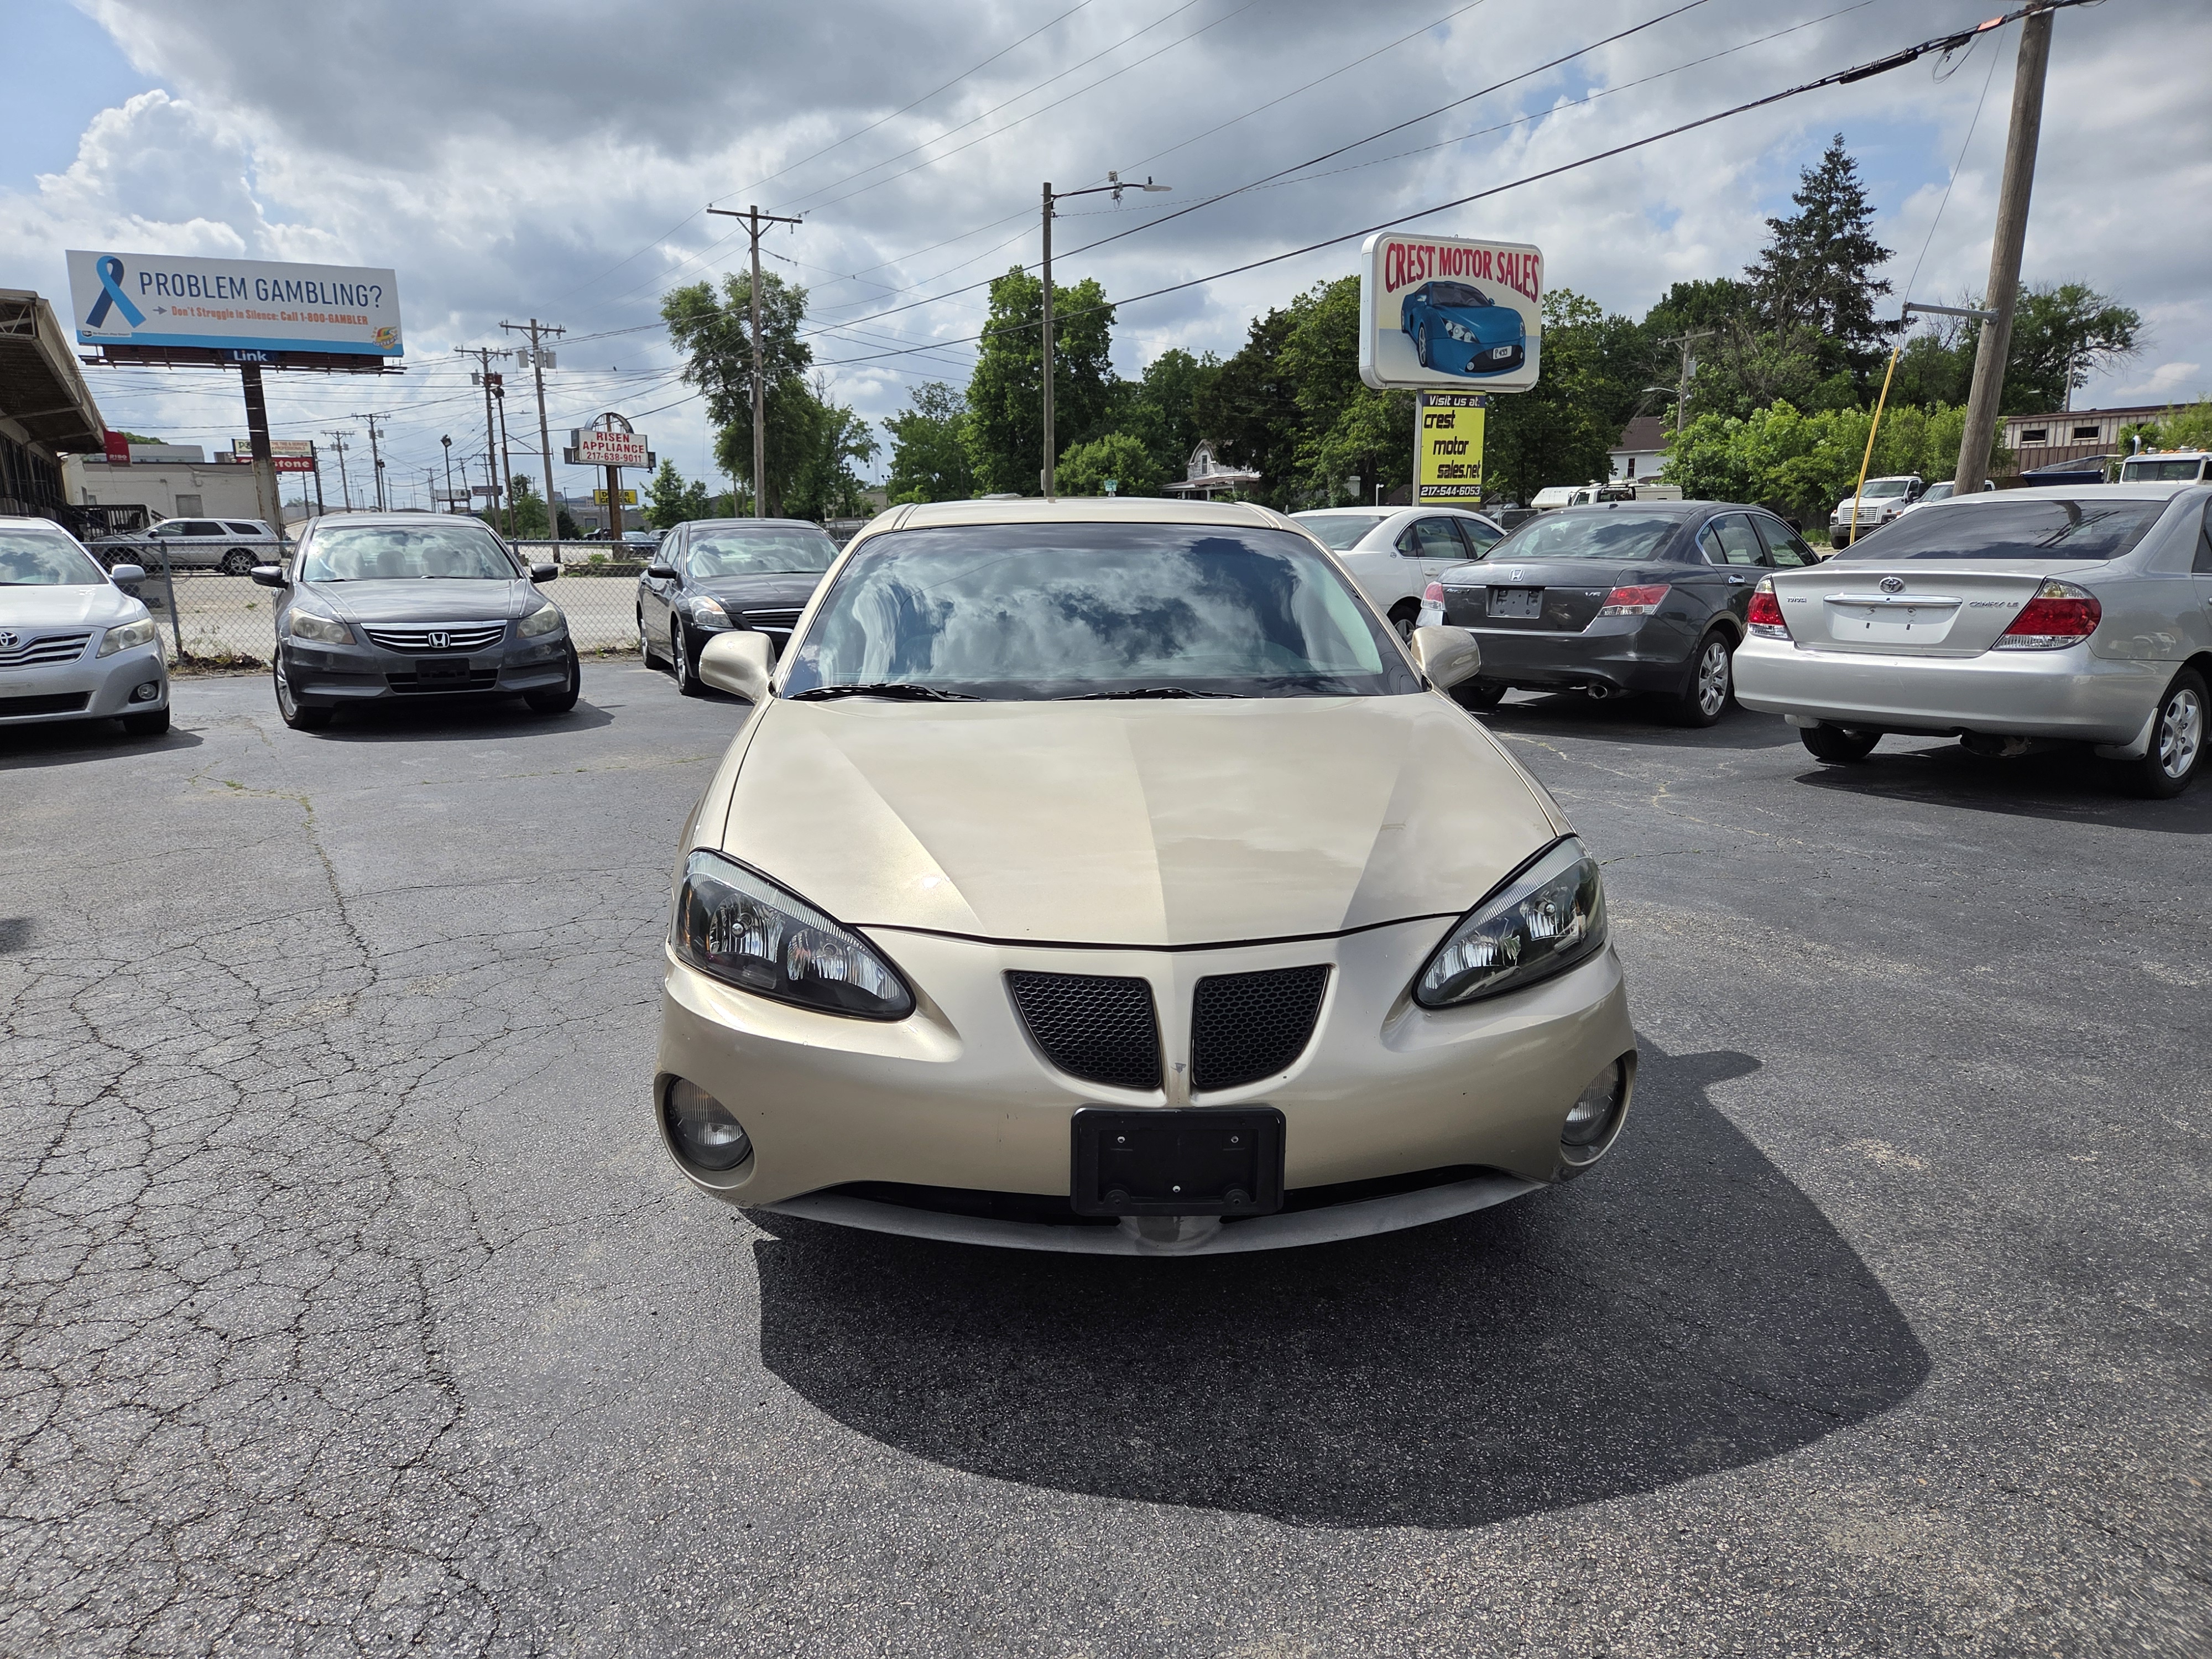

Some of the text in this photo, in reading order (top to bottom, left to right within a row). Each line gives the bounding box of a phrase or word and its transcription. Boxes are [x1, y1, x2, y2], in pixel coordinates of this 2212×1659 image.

[1385, 242, 1540, 304] CREST MOTOR SALES
[139, 272, 383, 308] PROBLEM GAMBLING?
[171, 306, 195, 316] Don't
[196, 307, 234, 320] Struggle
[280, 311, 299, 321] Call
[300, 312, 369, 325] 1-800-GAMBLER
[233, 350, 268, 362] Link
[1430, 395, 1480, 406] Visit us at:
[1423, 410, 1456, 429] crest
[597, 432, 630, 443] RISEN
[583, 441, 645, 453] APPLIANCE
[1432, 436, 1469, 455] motor
[587, 451, 641, 462] 217-638-9011
[1437, 460, 1481, 479] sales.net
[1421, 487, 1480, 496] 217-544-6053
